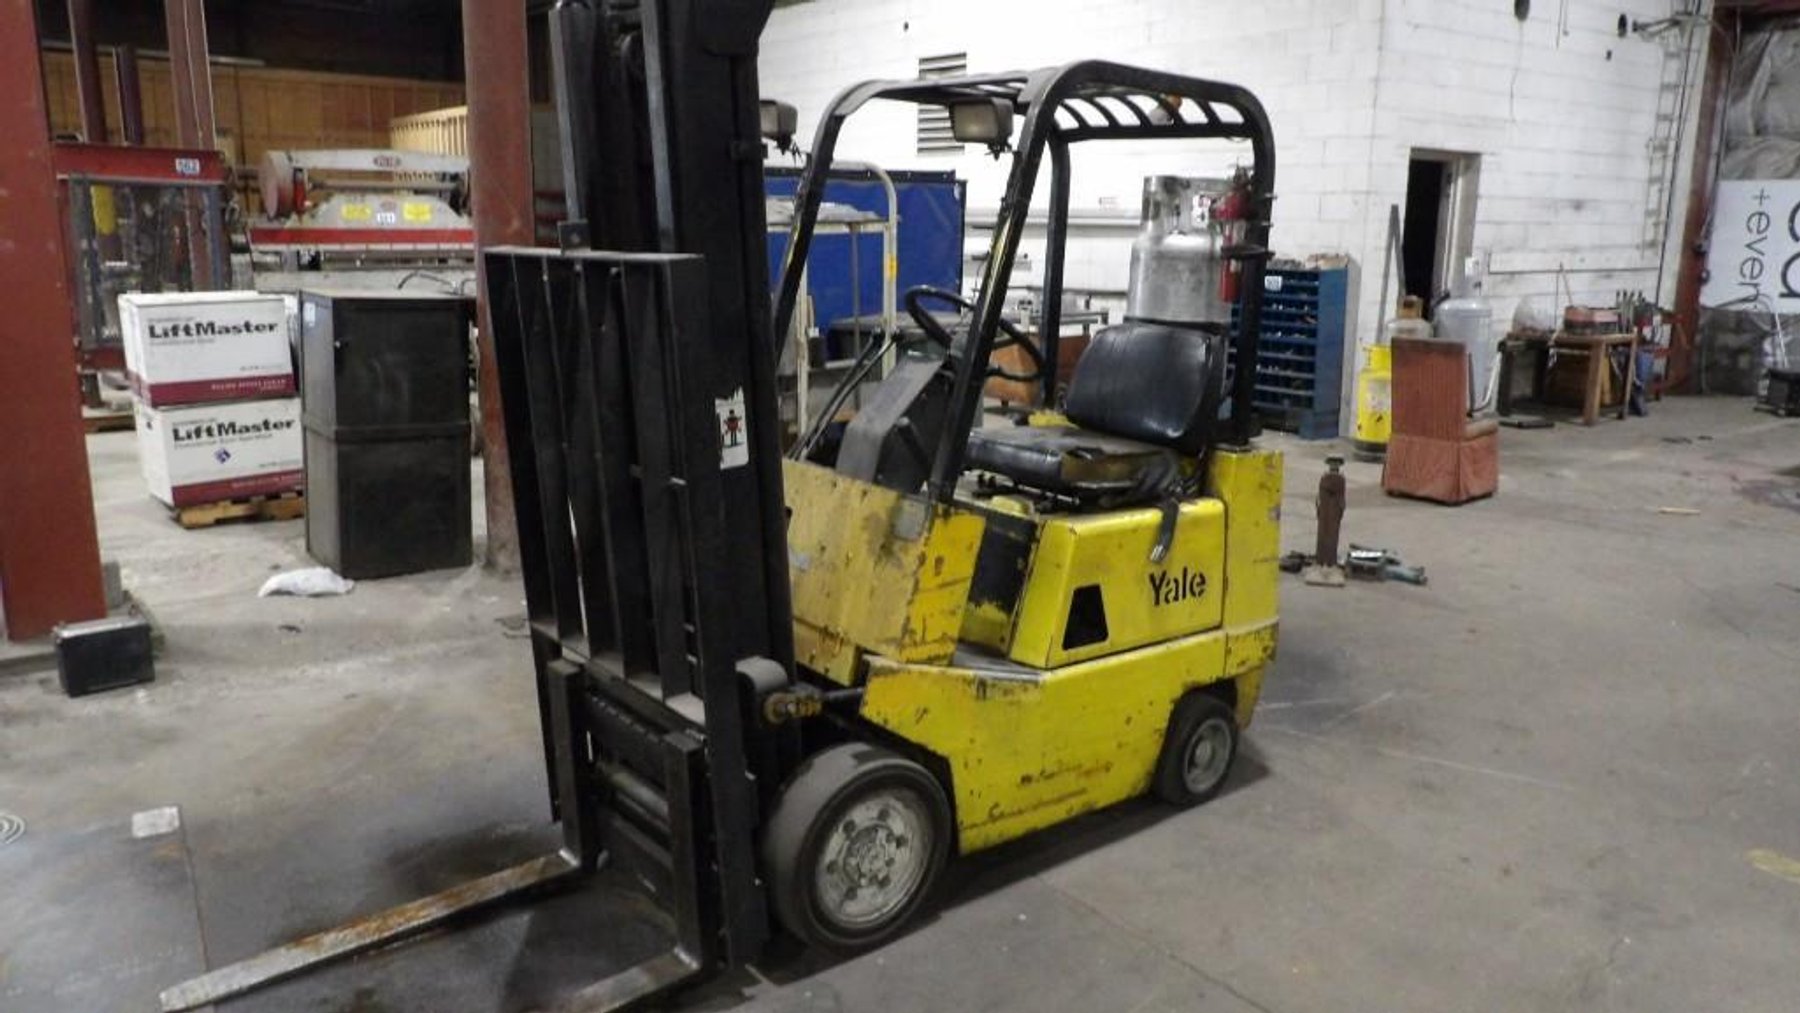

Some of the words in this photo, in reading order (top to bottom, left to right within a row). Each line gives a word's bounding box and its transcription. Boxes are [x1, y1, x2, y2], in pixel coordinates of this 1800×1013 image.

[148, 320, 278, 339] LiftMaster
[172, 418, 295, 442] LiftMaster
[1149, 566, 1206, 607] Yale
